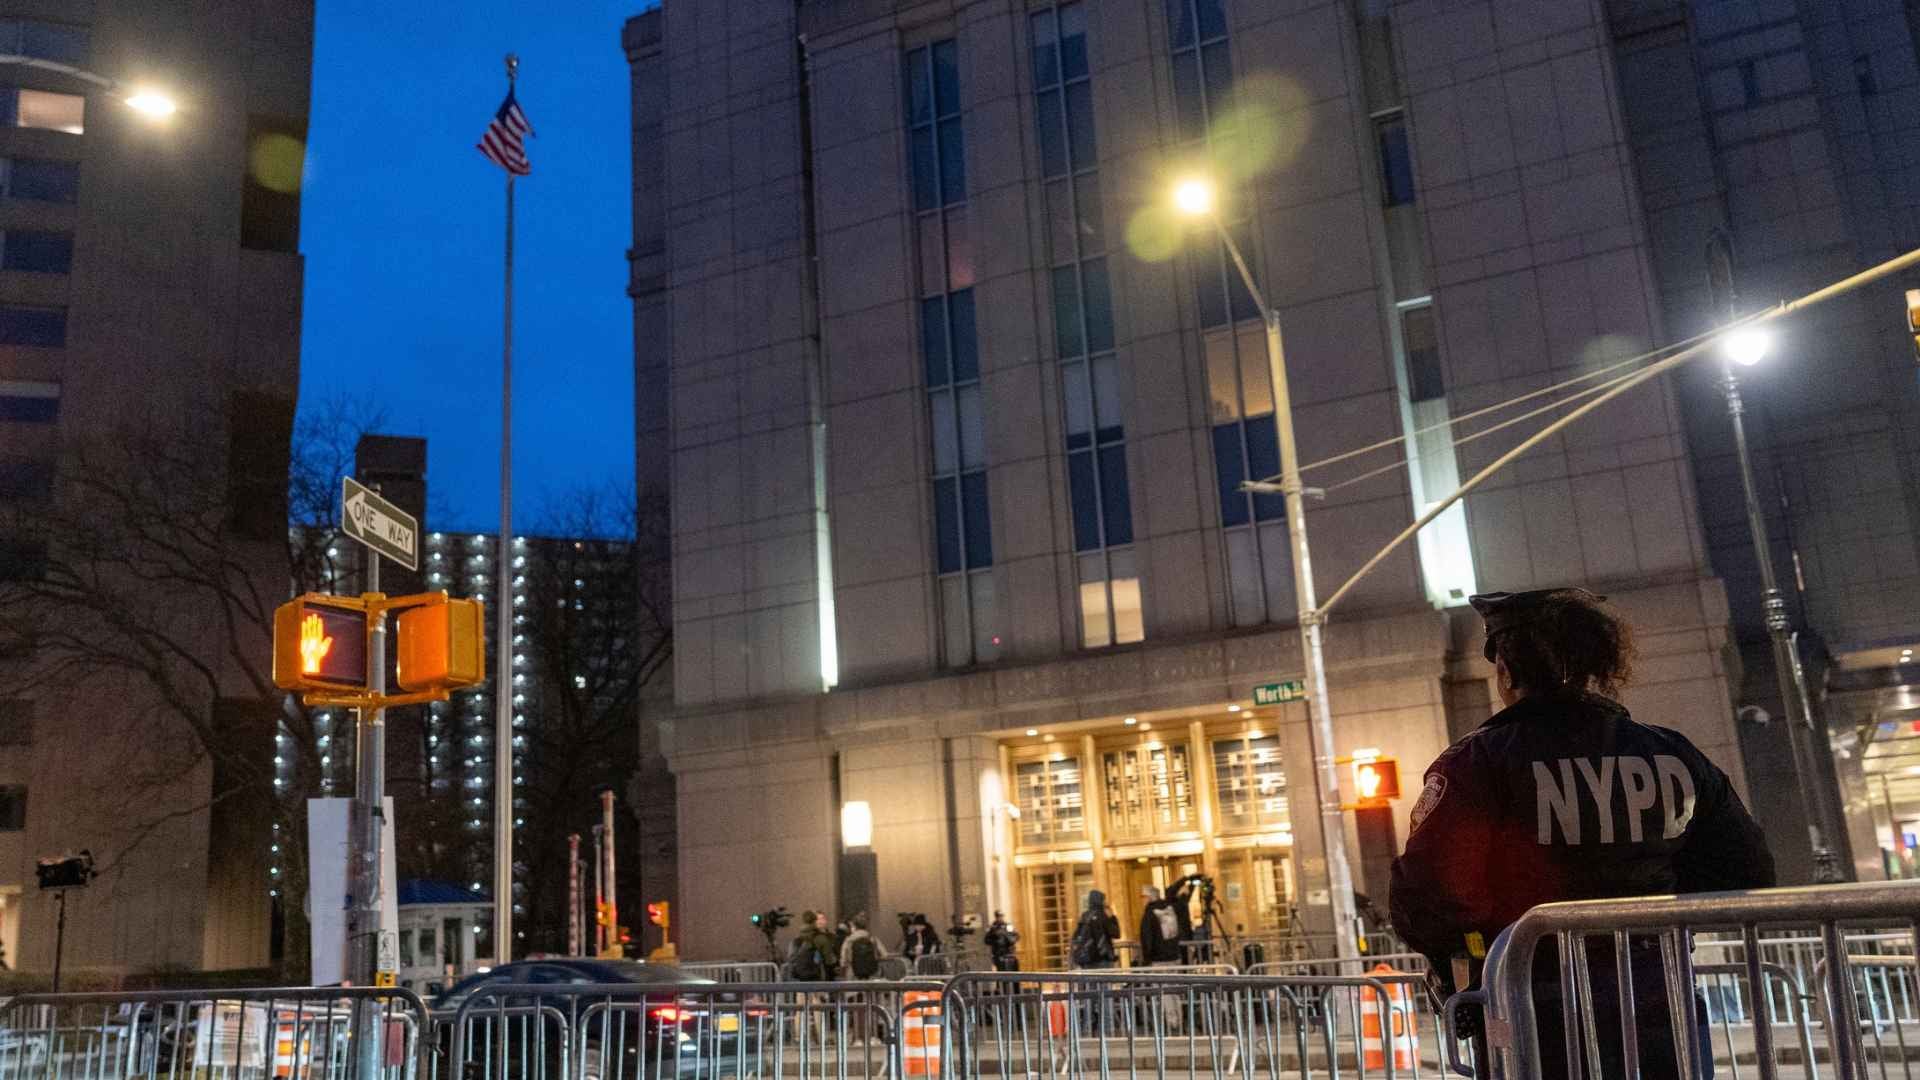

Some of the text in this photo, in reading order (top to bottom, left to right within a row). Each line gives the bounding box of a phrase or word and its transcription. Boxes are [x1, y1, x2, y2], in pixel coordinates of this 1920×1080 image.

[354, 501, 410, 549] ONE WAY
[1256, 685, 1291, 703] Worth
[1532, 755, 1696, 845] NYPD
